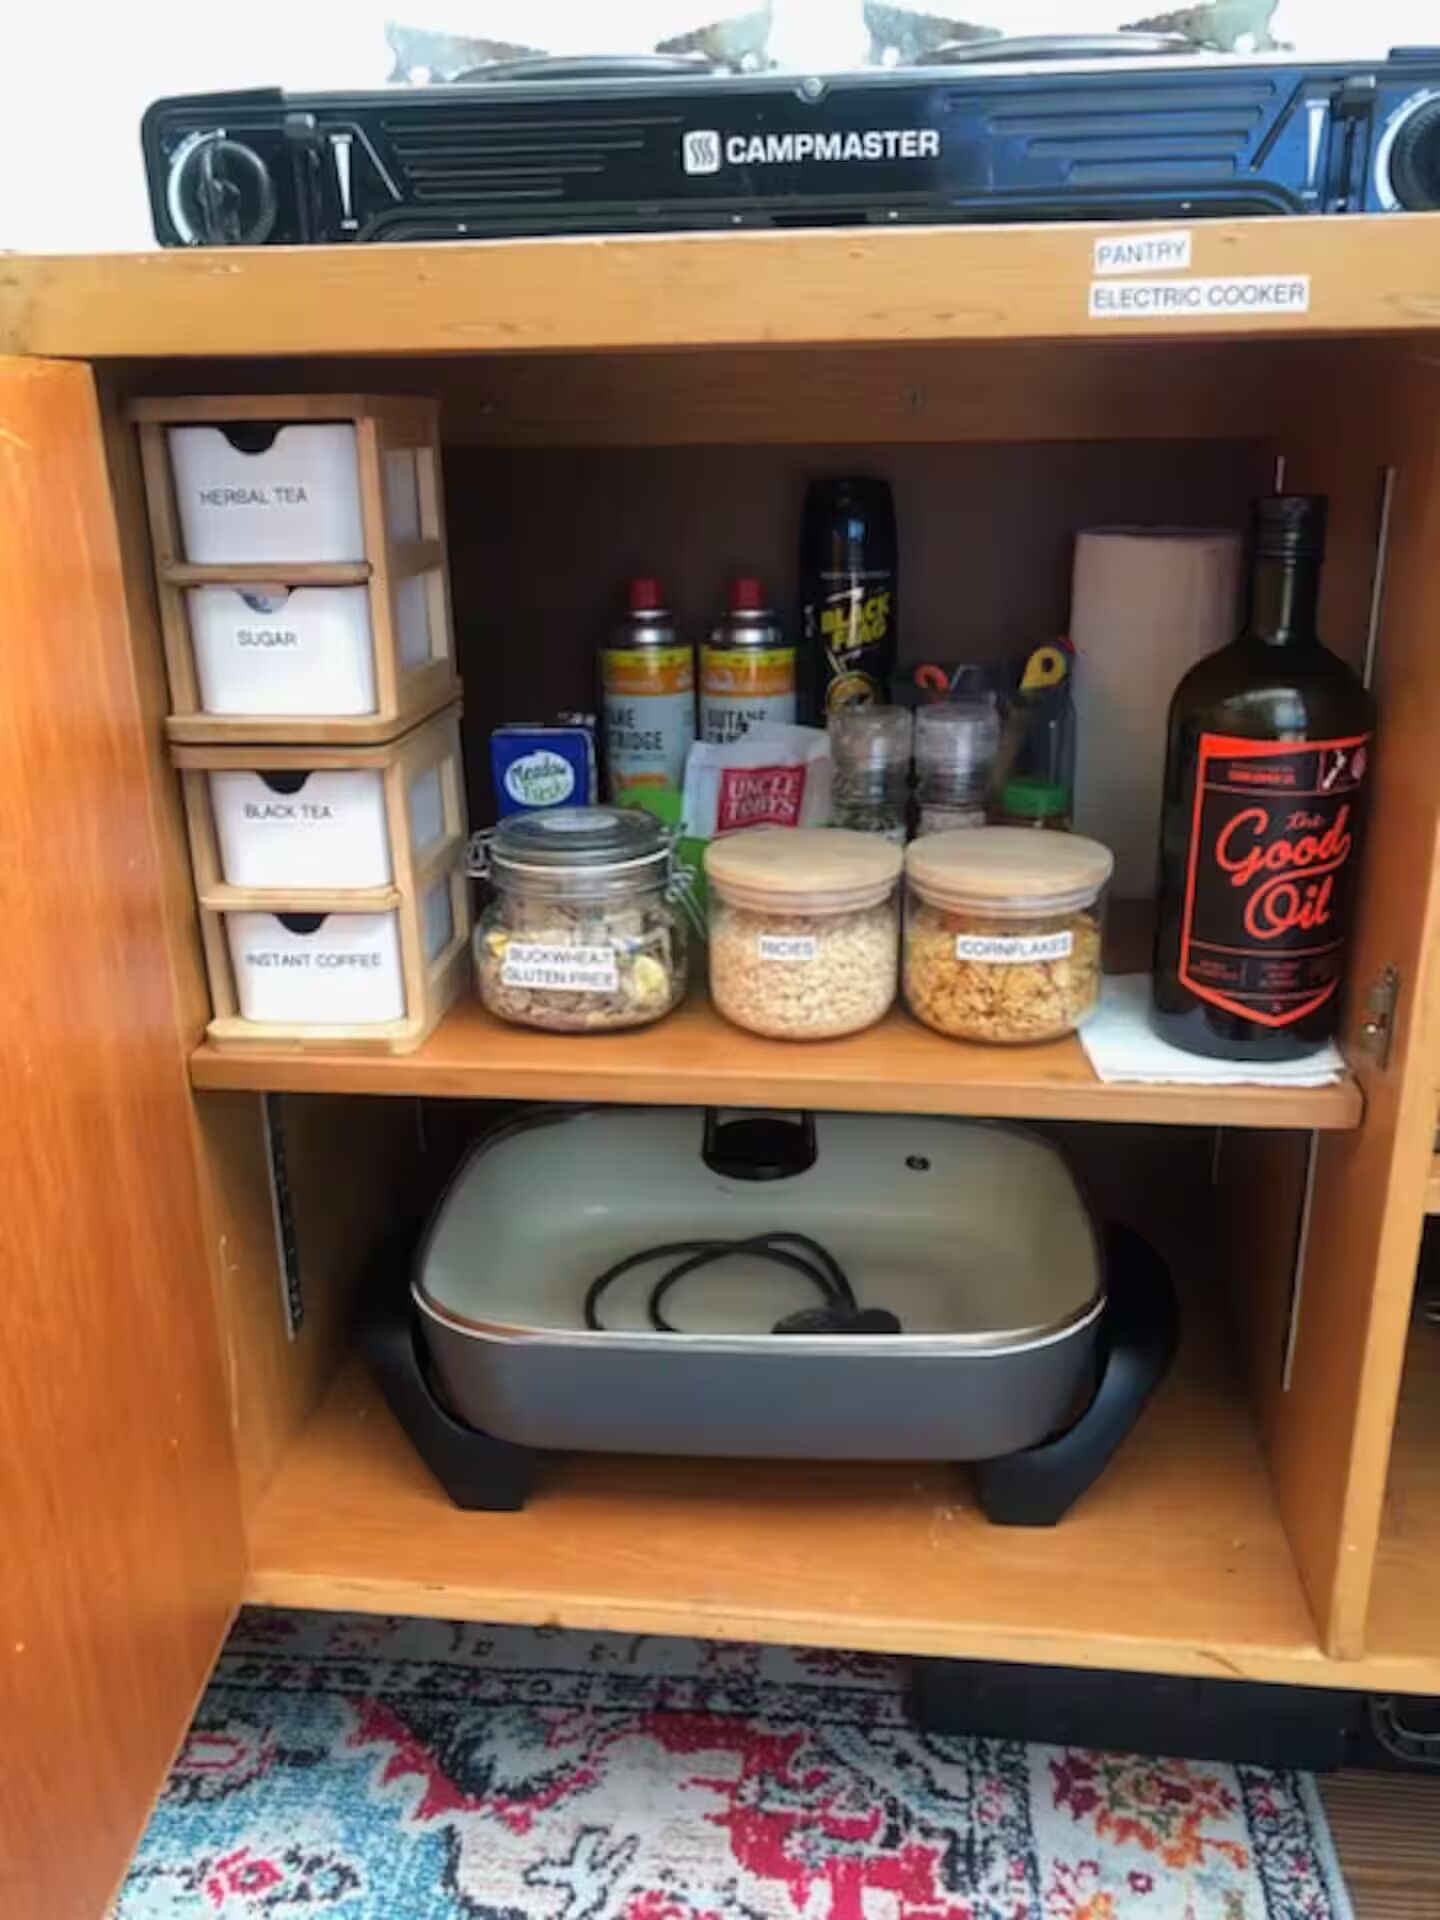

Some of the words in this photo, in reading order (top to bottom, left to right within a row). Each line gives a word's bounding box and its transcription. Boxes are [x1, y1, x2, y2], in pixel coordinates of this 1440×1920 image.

[726, 130, 940, 164] CAMPMASTER
[1098, 239, 1187, 264] PANTRY
[1093, 286, 1200, 310] ELECTRIC
[1207, 282, 1305, 306] COOKER
[200, 486, 268, 507] HERBAL
[273, 487, 309, 503] TEA
[820, 592, 890, 635] BLACK
[237, 629, 298, 648] SUGAR
[727, 774, 800, 799] UNCLE
[244, 803, 296, 820] BLACK
[301, 803, 332, 819] TEA
[1216, 805, 1351, 886] Good
[1244, 874, 1333, 940] Oil
[509, 948, 611, 963] BUCKWHEAT
[959, 936, 1068, 957] CORNFLAKES
[245, 953, 311, 969] INSTANT
[316, 953, 382, 968] COFFEE
[505, 966, 565, 983] GLUTEN
[568, 971, 611, 984] FREE
